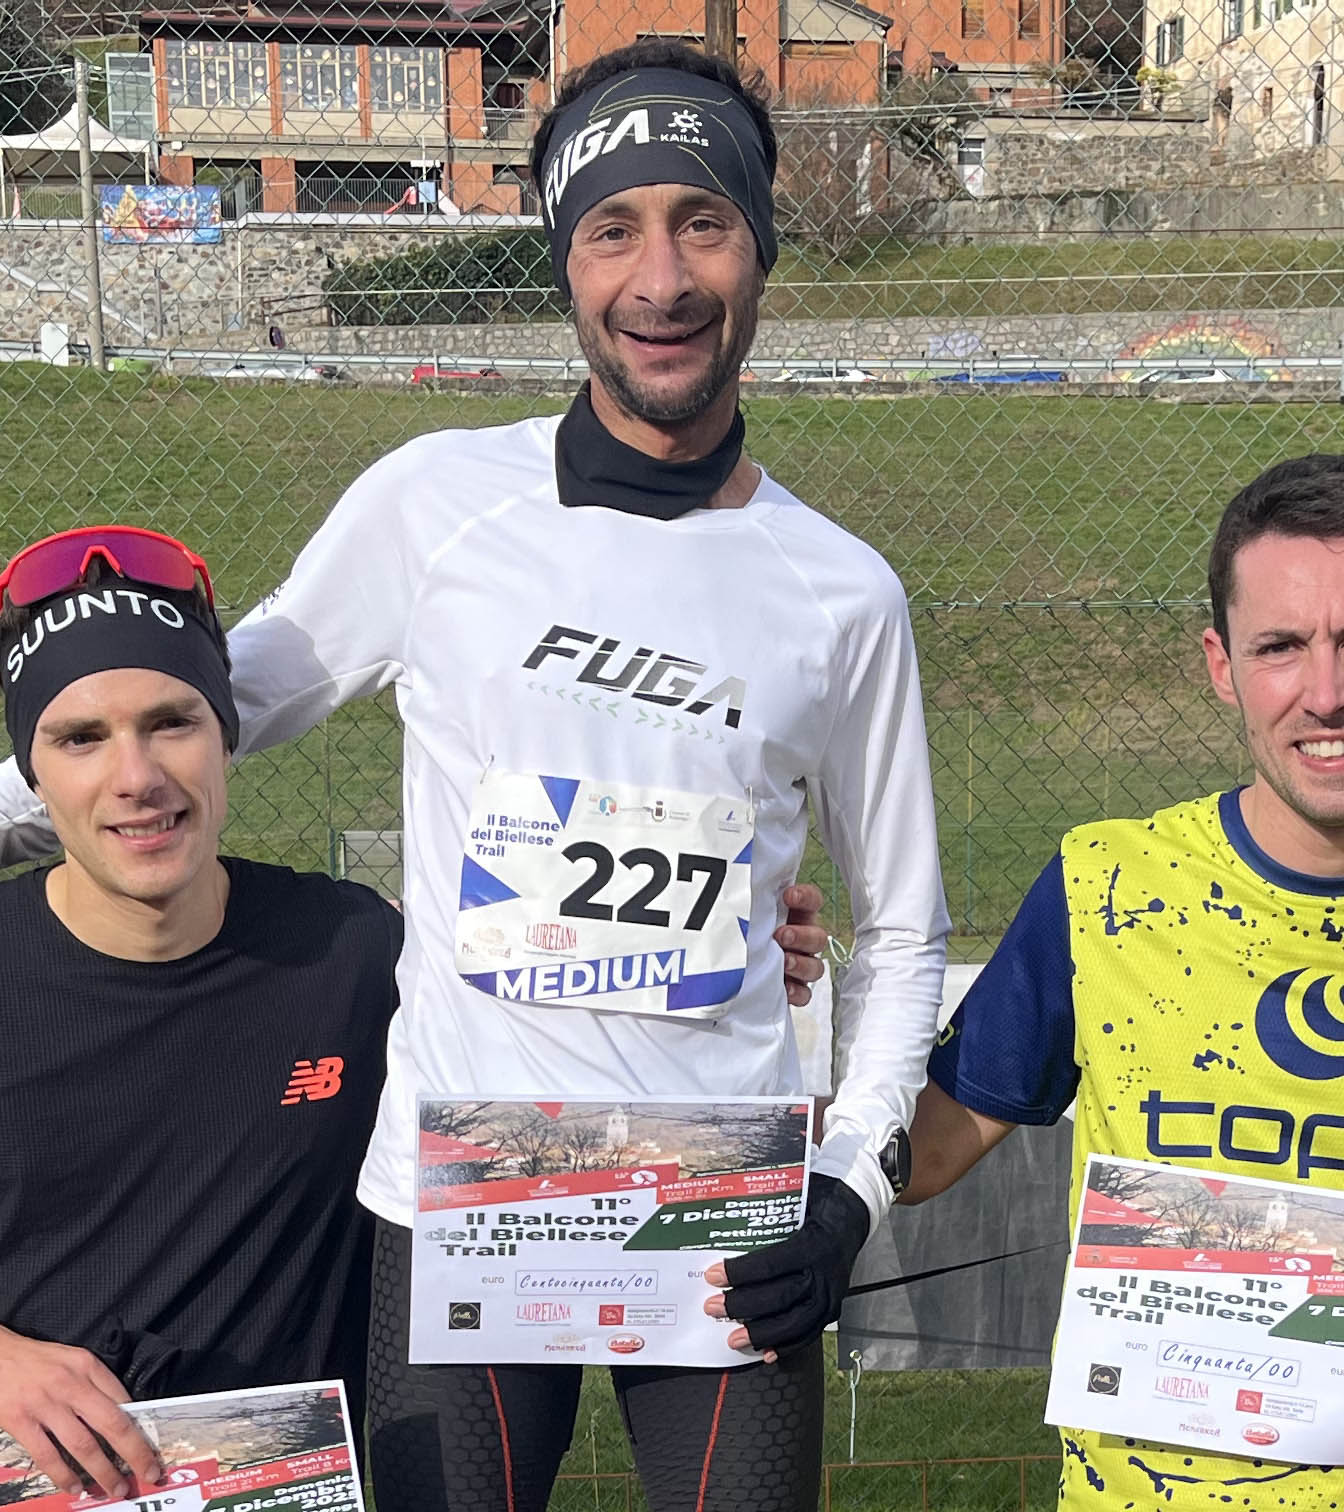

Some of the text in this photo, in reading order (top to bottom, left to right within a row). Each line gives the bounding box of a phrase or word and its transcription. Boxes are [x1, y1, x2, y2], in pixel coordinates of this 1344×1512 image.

[660, 134, 709, 147] KAILAS
[545, 108, 649, 230] FUGA
[7, 590, 185, 682] SUUNTO
[522, 624, 747, 729] FUGA
[499, 815, 560, 832] Balcone
[471, 828, 554, 846] del Biellese
[476, 844, 505, 858] Trail
[560, 841, 727, 930] 227
[525, 923, 576, 950] LAURETANA
[496, 951, 682, 1000] MEDIUM
[661, 1179, 719, 1190] MEDIUM
[744, 1173, 789, 1182] SMALL
[747, 1182, 774, 1190] Trail
[665, 1188, 693, 1197] Trail
[466, 1213, 639, 1225] Il Balcone
[660, 1213, 677, 1225] 7
[424, 1228, 628, 1242] del Biellese
[440, 1244, 517, 1257] Trail
[481, 1276, 504, 1284] euro
[1118, 1275, 1288, 1312] Il Balcone
[516, 1302, 572, 1322] LAURETANA
[1077, 1286, 1275, 1326] del Biellese
[1090, 1303, 1164, 1325] Trail
[1308, 1305, 1325, 1315] 7
[1125, 1340, 1148, 1351] euro
[1163, 1344, 1294, 1380] Cinquanta/00
[1155, 1376, 1209, 1399] LAURETANA
[287, 1454, 334, 1468] SMALL
[204, 1469, 263, 1486] MEDIUM
